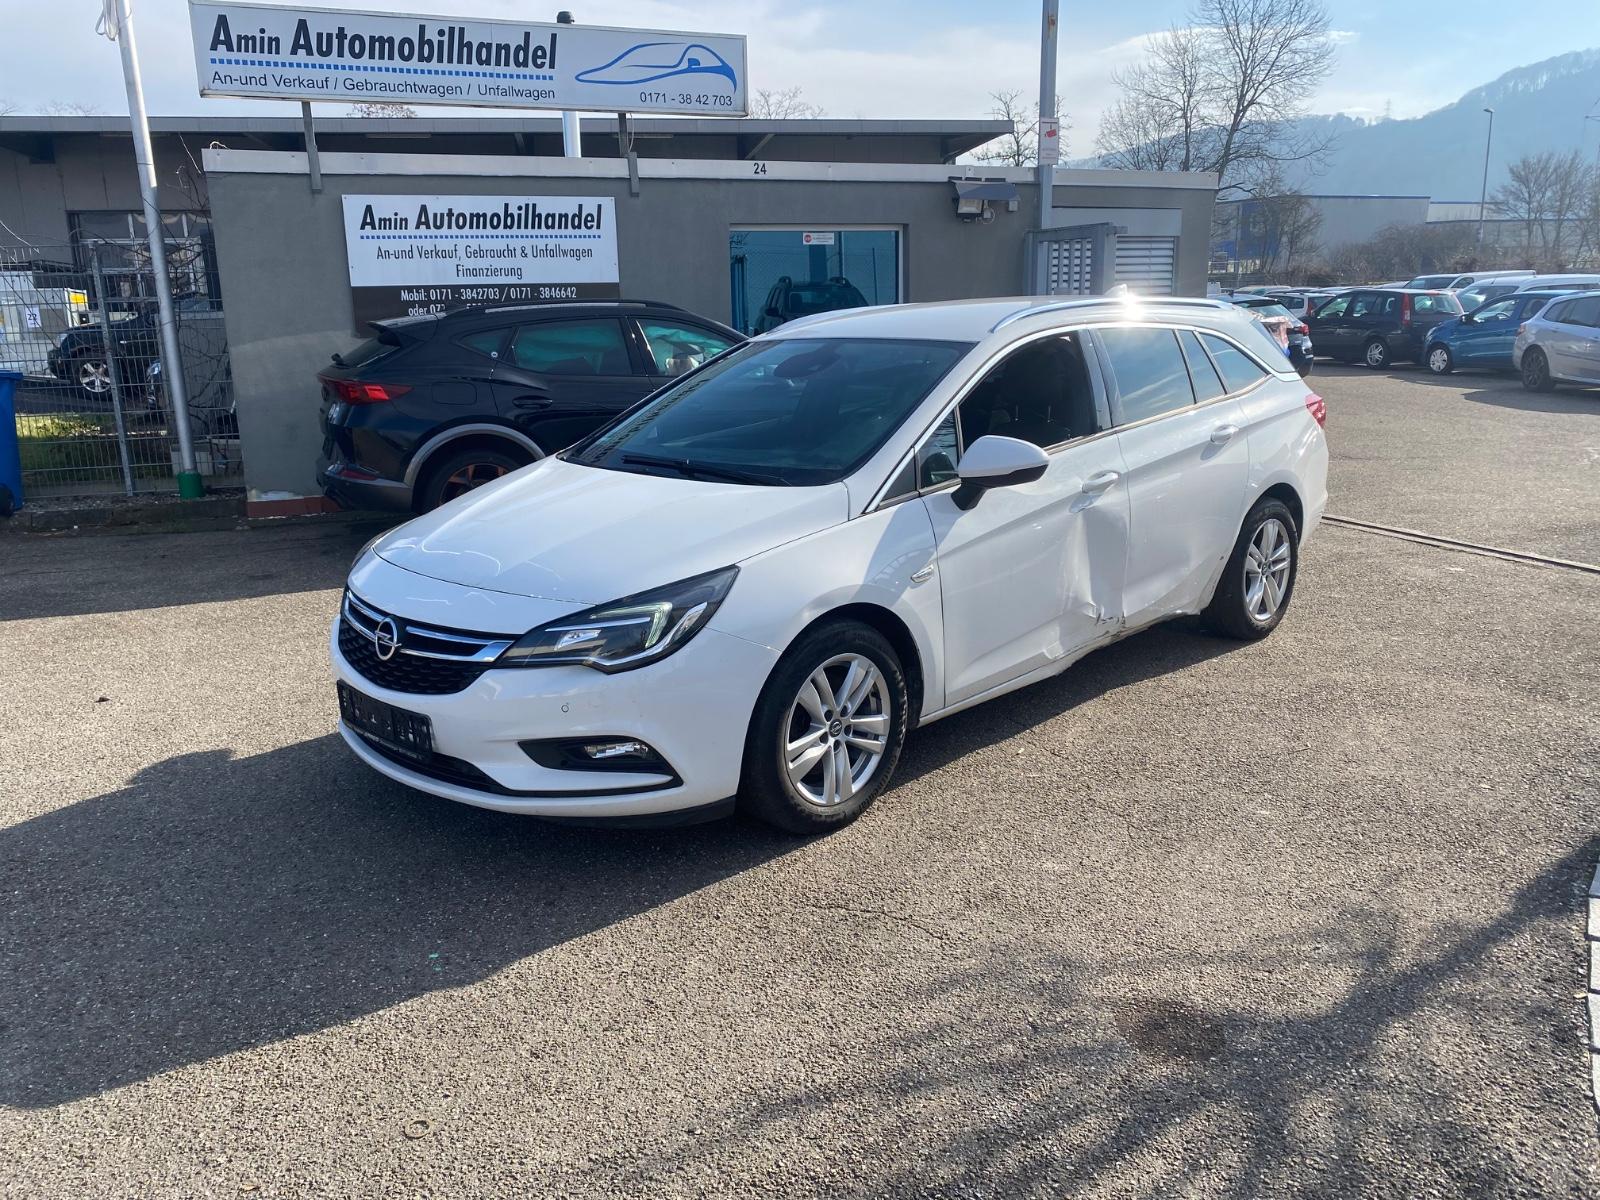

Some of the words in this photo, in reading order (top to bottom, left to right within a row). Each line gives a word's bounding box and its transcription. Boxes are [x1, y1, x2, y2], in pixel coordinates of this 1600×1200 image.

[210, 14, 281, 55] Amin
[290, 18, 558, 70] Automobilhandel
[211, 71, 267, 88] An-und
[272, 74, 330, 90] Verkauf
[343, 77, 463, 97] Gebrauchtwagen
[478, 84, 555, 100] Unfallwagen
[639, 91, 667, 104] 0171
[678, 93, 693, 105] 38
[695, 94, 709, 105] 42
[710, 95, 733, 106] 703
[753, 162, 767, 175] 24
[359, 204, 409, 231] Amin
[414, 203, 603, 231] Automobilhandel
[376, 245, 414, 260] An-und
[416, 244, 461, 261] Verkauf,
[465, 245, 518, 260] Gebraucht
[520, 246, 528, 259] &
[531, 244, 593, 261] Unfallwagen
[456, 263, 523, 280] Finanzierung
[400, 288, 428, 301] Mobil:
[429, 288, 452, 300] 0171
[460, 287, 499, 300] 3842703
[510, 287, 532, 299] 0171
[539, 287, 577, 298] 3846642
[408, 303, 428, 316] oder
